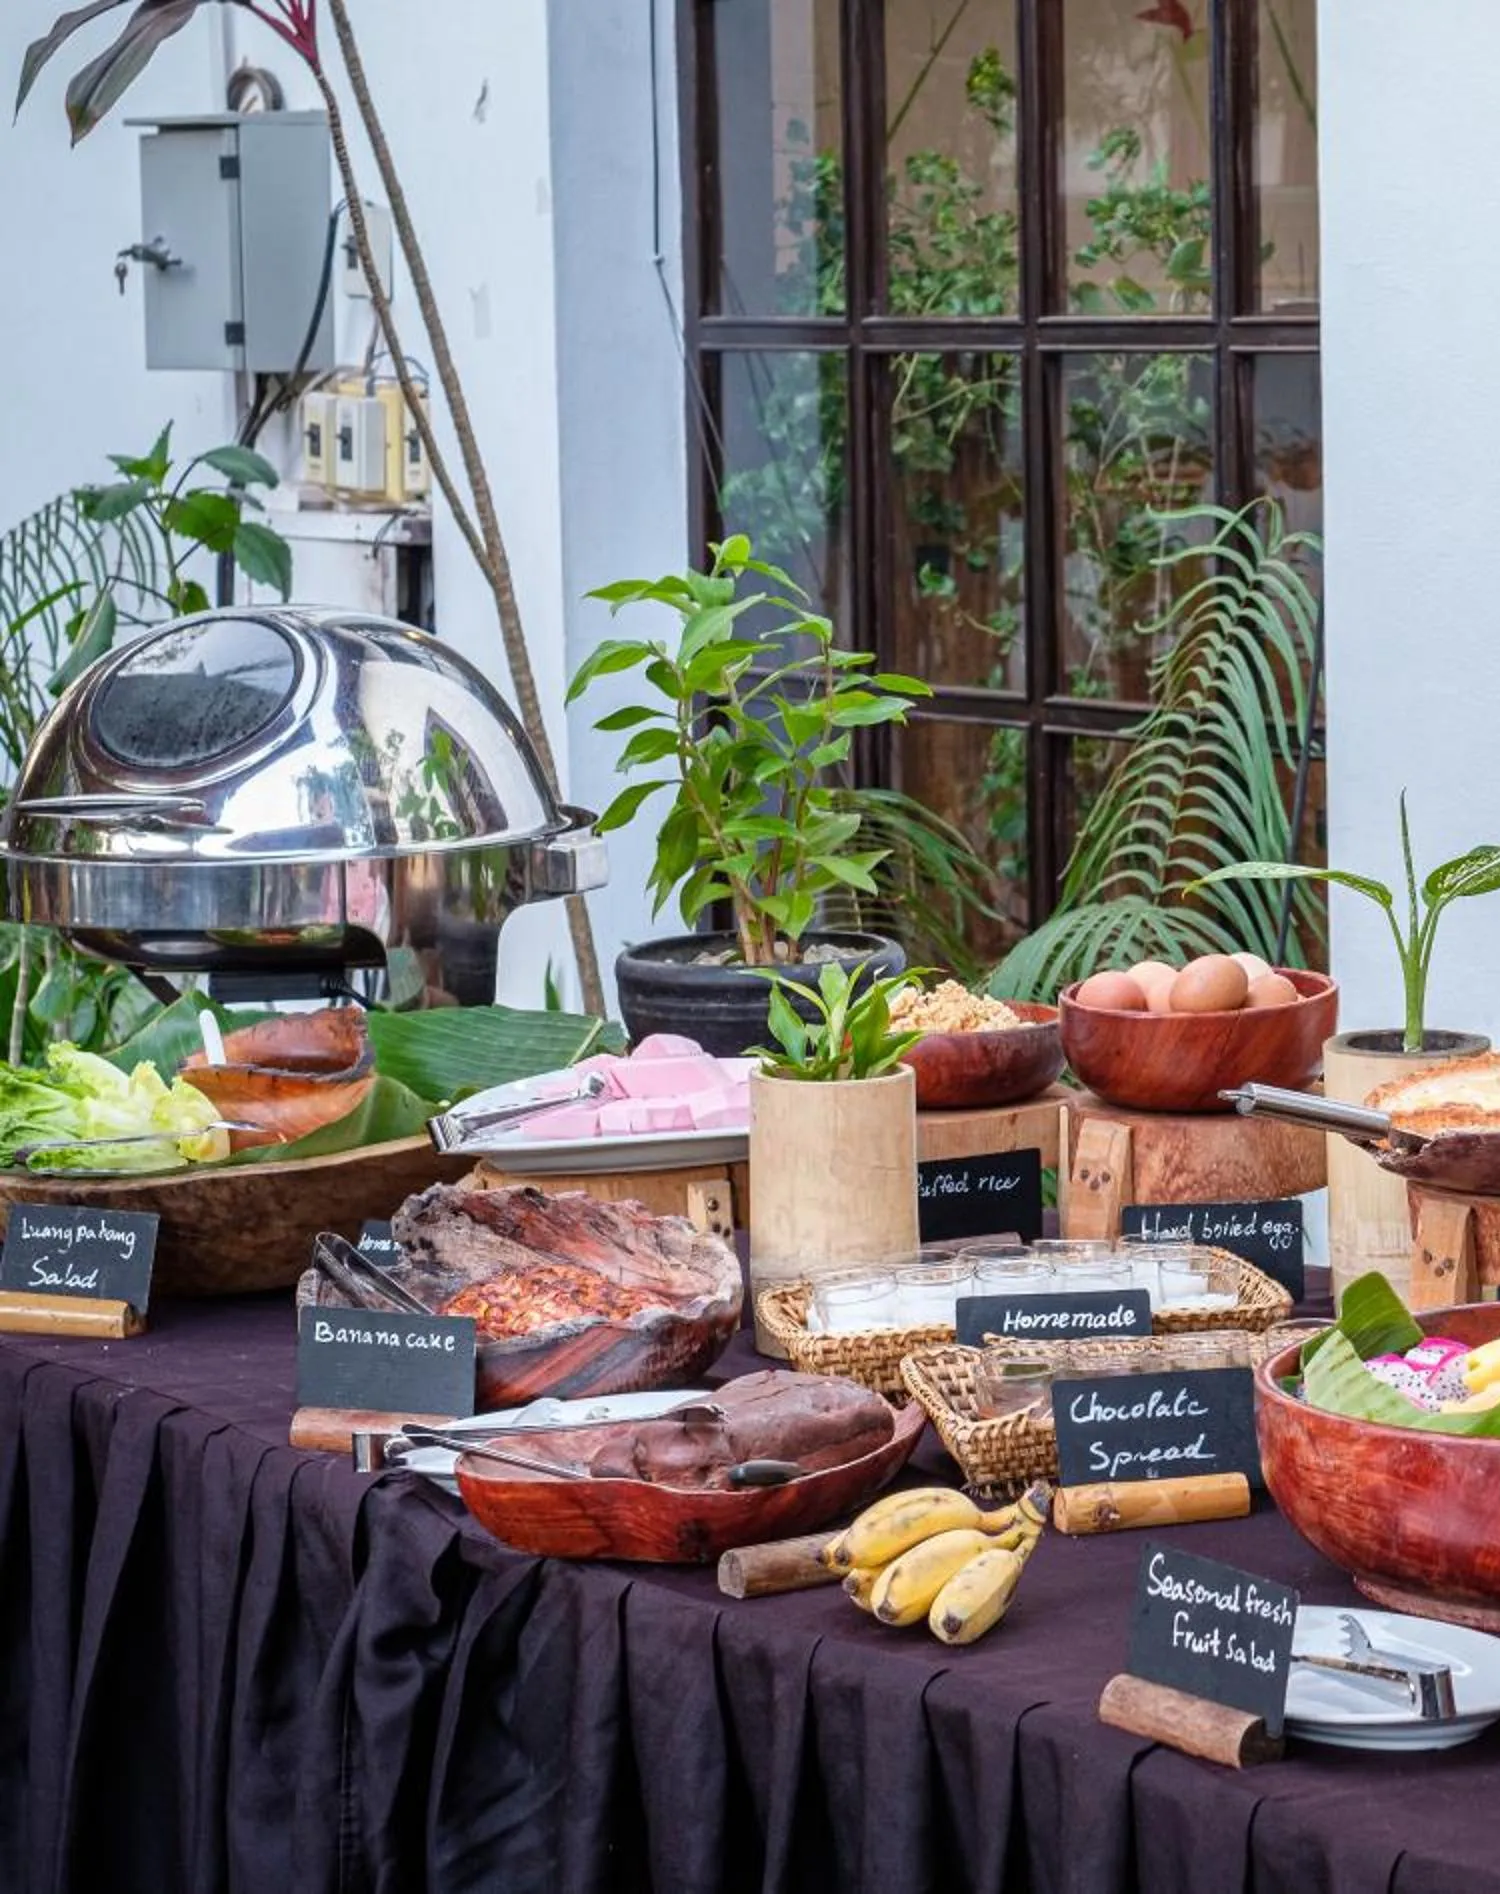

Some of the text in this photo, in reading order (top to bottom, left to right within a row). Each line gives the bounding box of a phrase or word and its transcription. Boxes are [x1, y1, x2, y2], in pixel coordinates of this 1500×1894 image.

[979, 1175, 1021, 1191] rice
[28, 1255, 100, 1289] Salad
[1003, 1303, 1138, 1332] Homemade
[314, 1320, 456, 1351] Banana cake
[1089, 1433, 1217, 1477] Spread
[1147, 1551, 1293, 1626] Seasonal fresh
